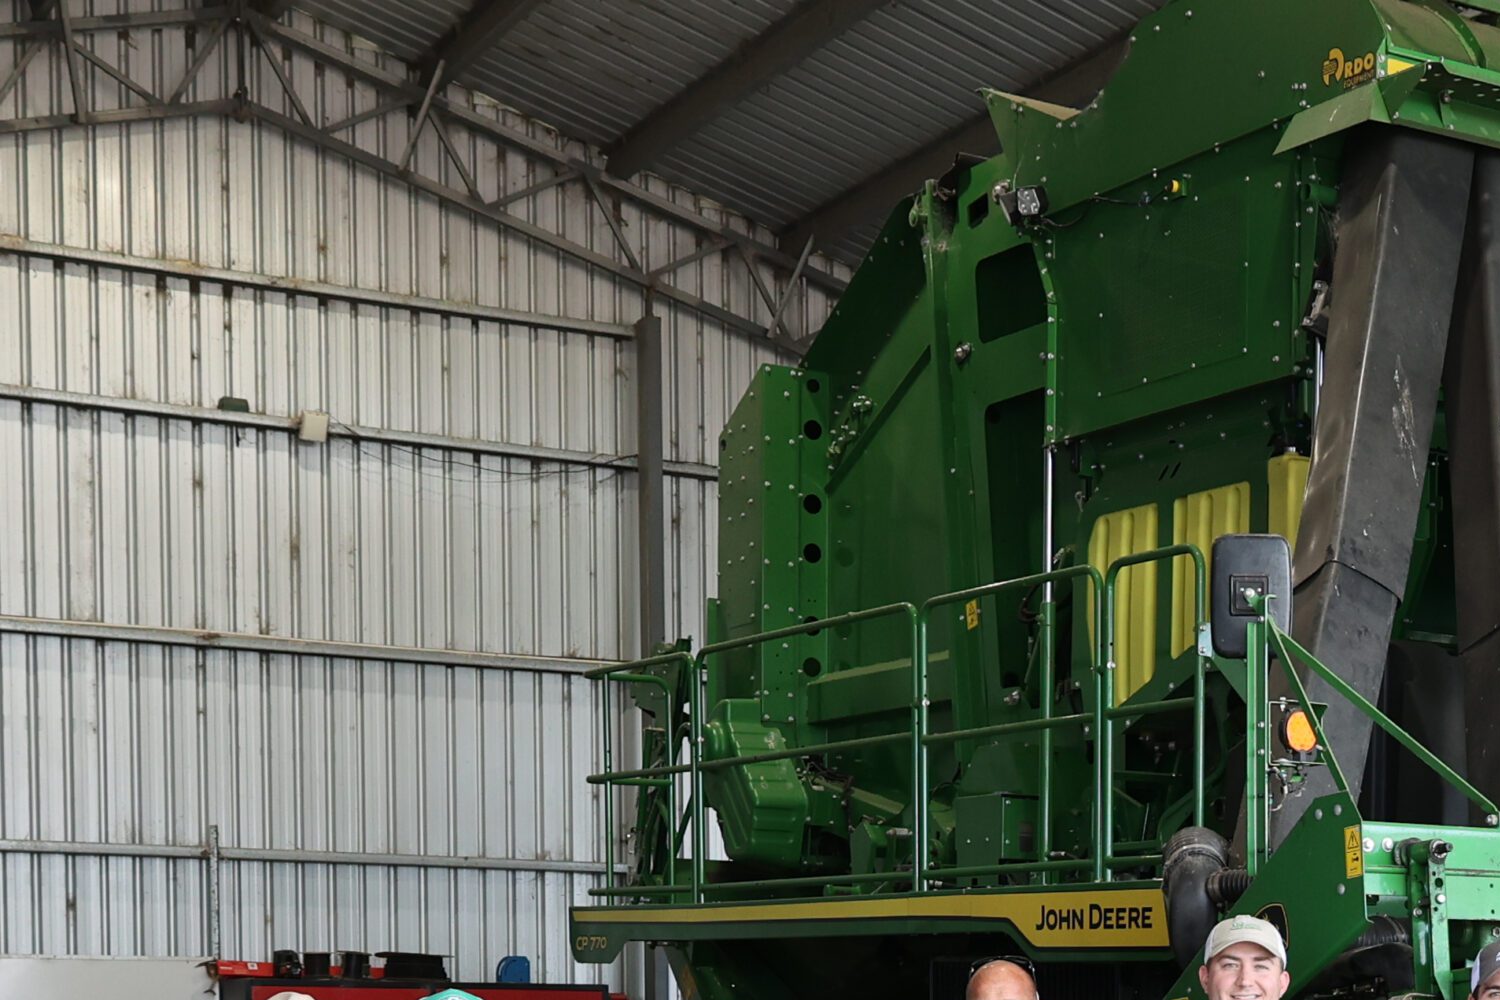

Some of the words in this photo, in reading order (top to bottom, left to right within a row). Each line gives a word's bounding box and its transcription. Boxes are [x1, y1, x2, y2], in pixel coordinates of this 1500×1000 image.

[1036, 905, 1084, 930] JOHN
[1089, 904, 1153, 930] DEERE
[576, 936, 589, 951] CP
[590, 936, 608, 951] 770
